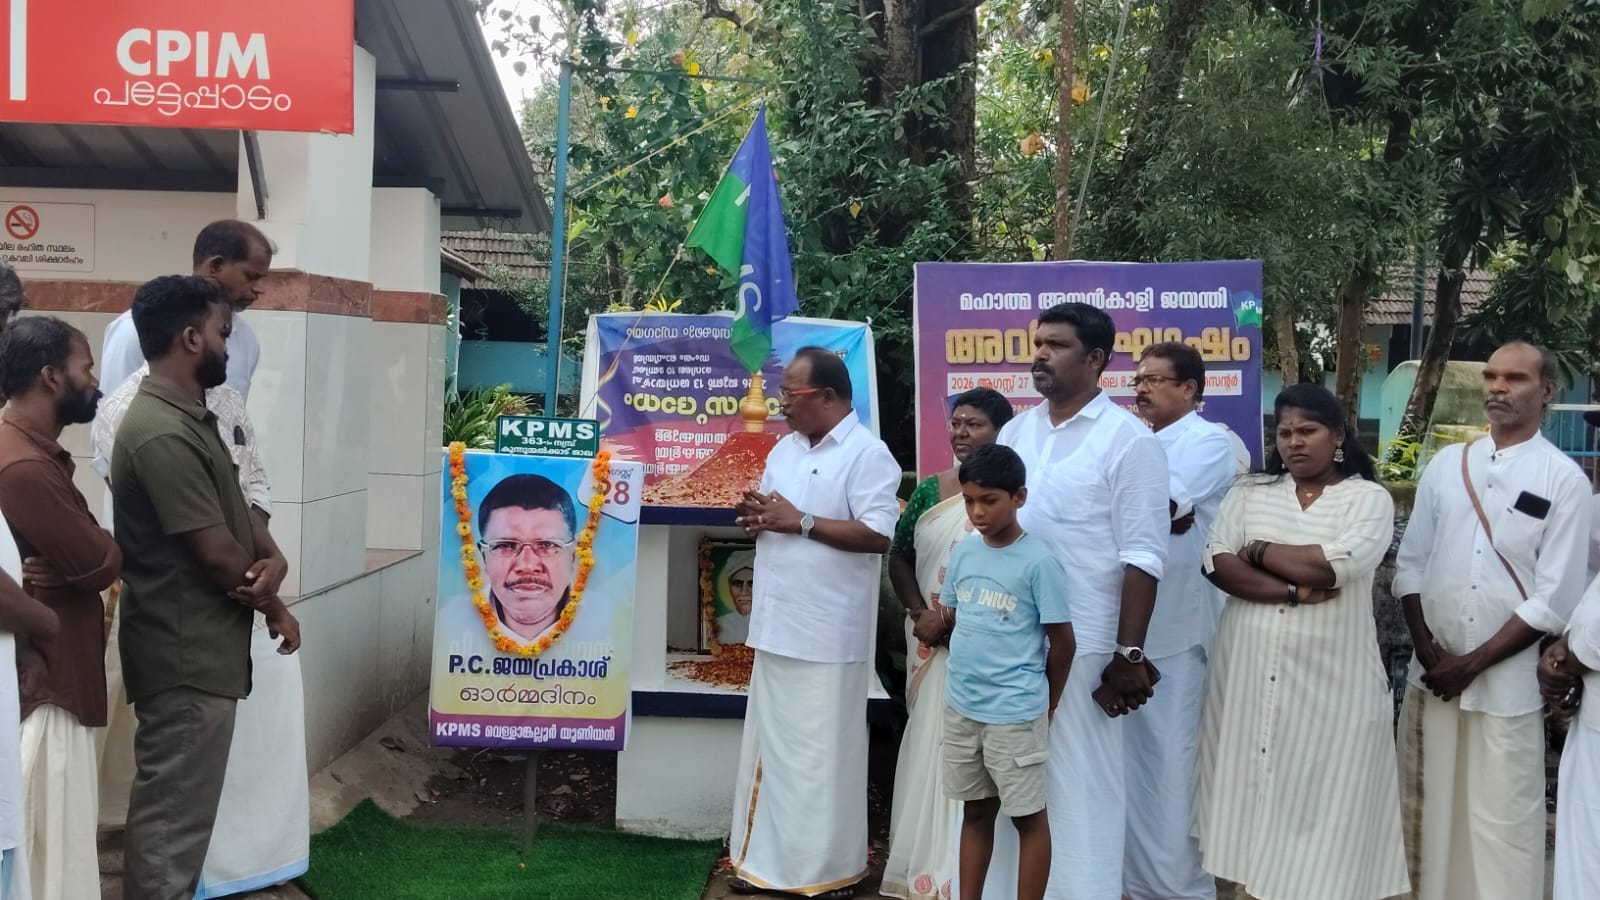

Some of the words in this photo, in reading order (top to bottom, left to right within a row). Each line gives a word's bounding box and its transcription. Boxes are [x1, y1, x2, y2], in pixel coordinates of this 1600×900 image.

[116, 28, 271, 79] CPIM
[94, 80, 291, 116] പട്ടേപ്പാടം
[960, 292, 1031, 311] മഹാത്മ
[1161, 286, 1227, 309] ജയന്തി
[684, 327, 733, 340] വർക്കും
[666, 366, 675, 375] 10
[693, 377, 705, 388] 13
[951, 377, 974, 389] 2026
[1018, 377, 1029, 389] 27
[502, 420, 594, 439] KPMS
[459, 683, 597, 705] ഓർമ്മദിനം
[436, 723, 481, 737] KPMS
